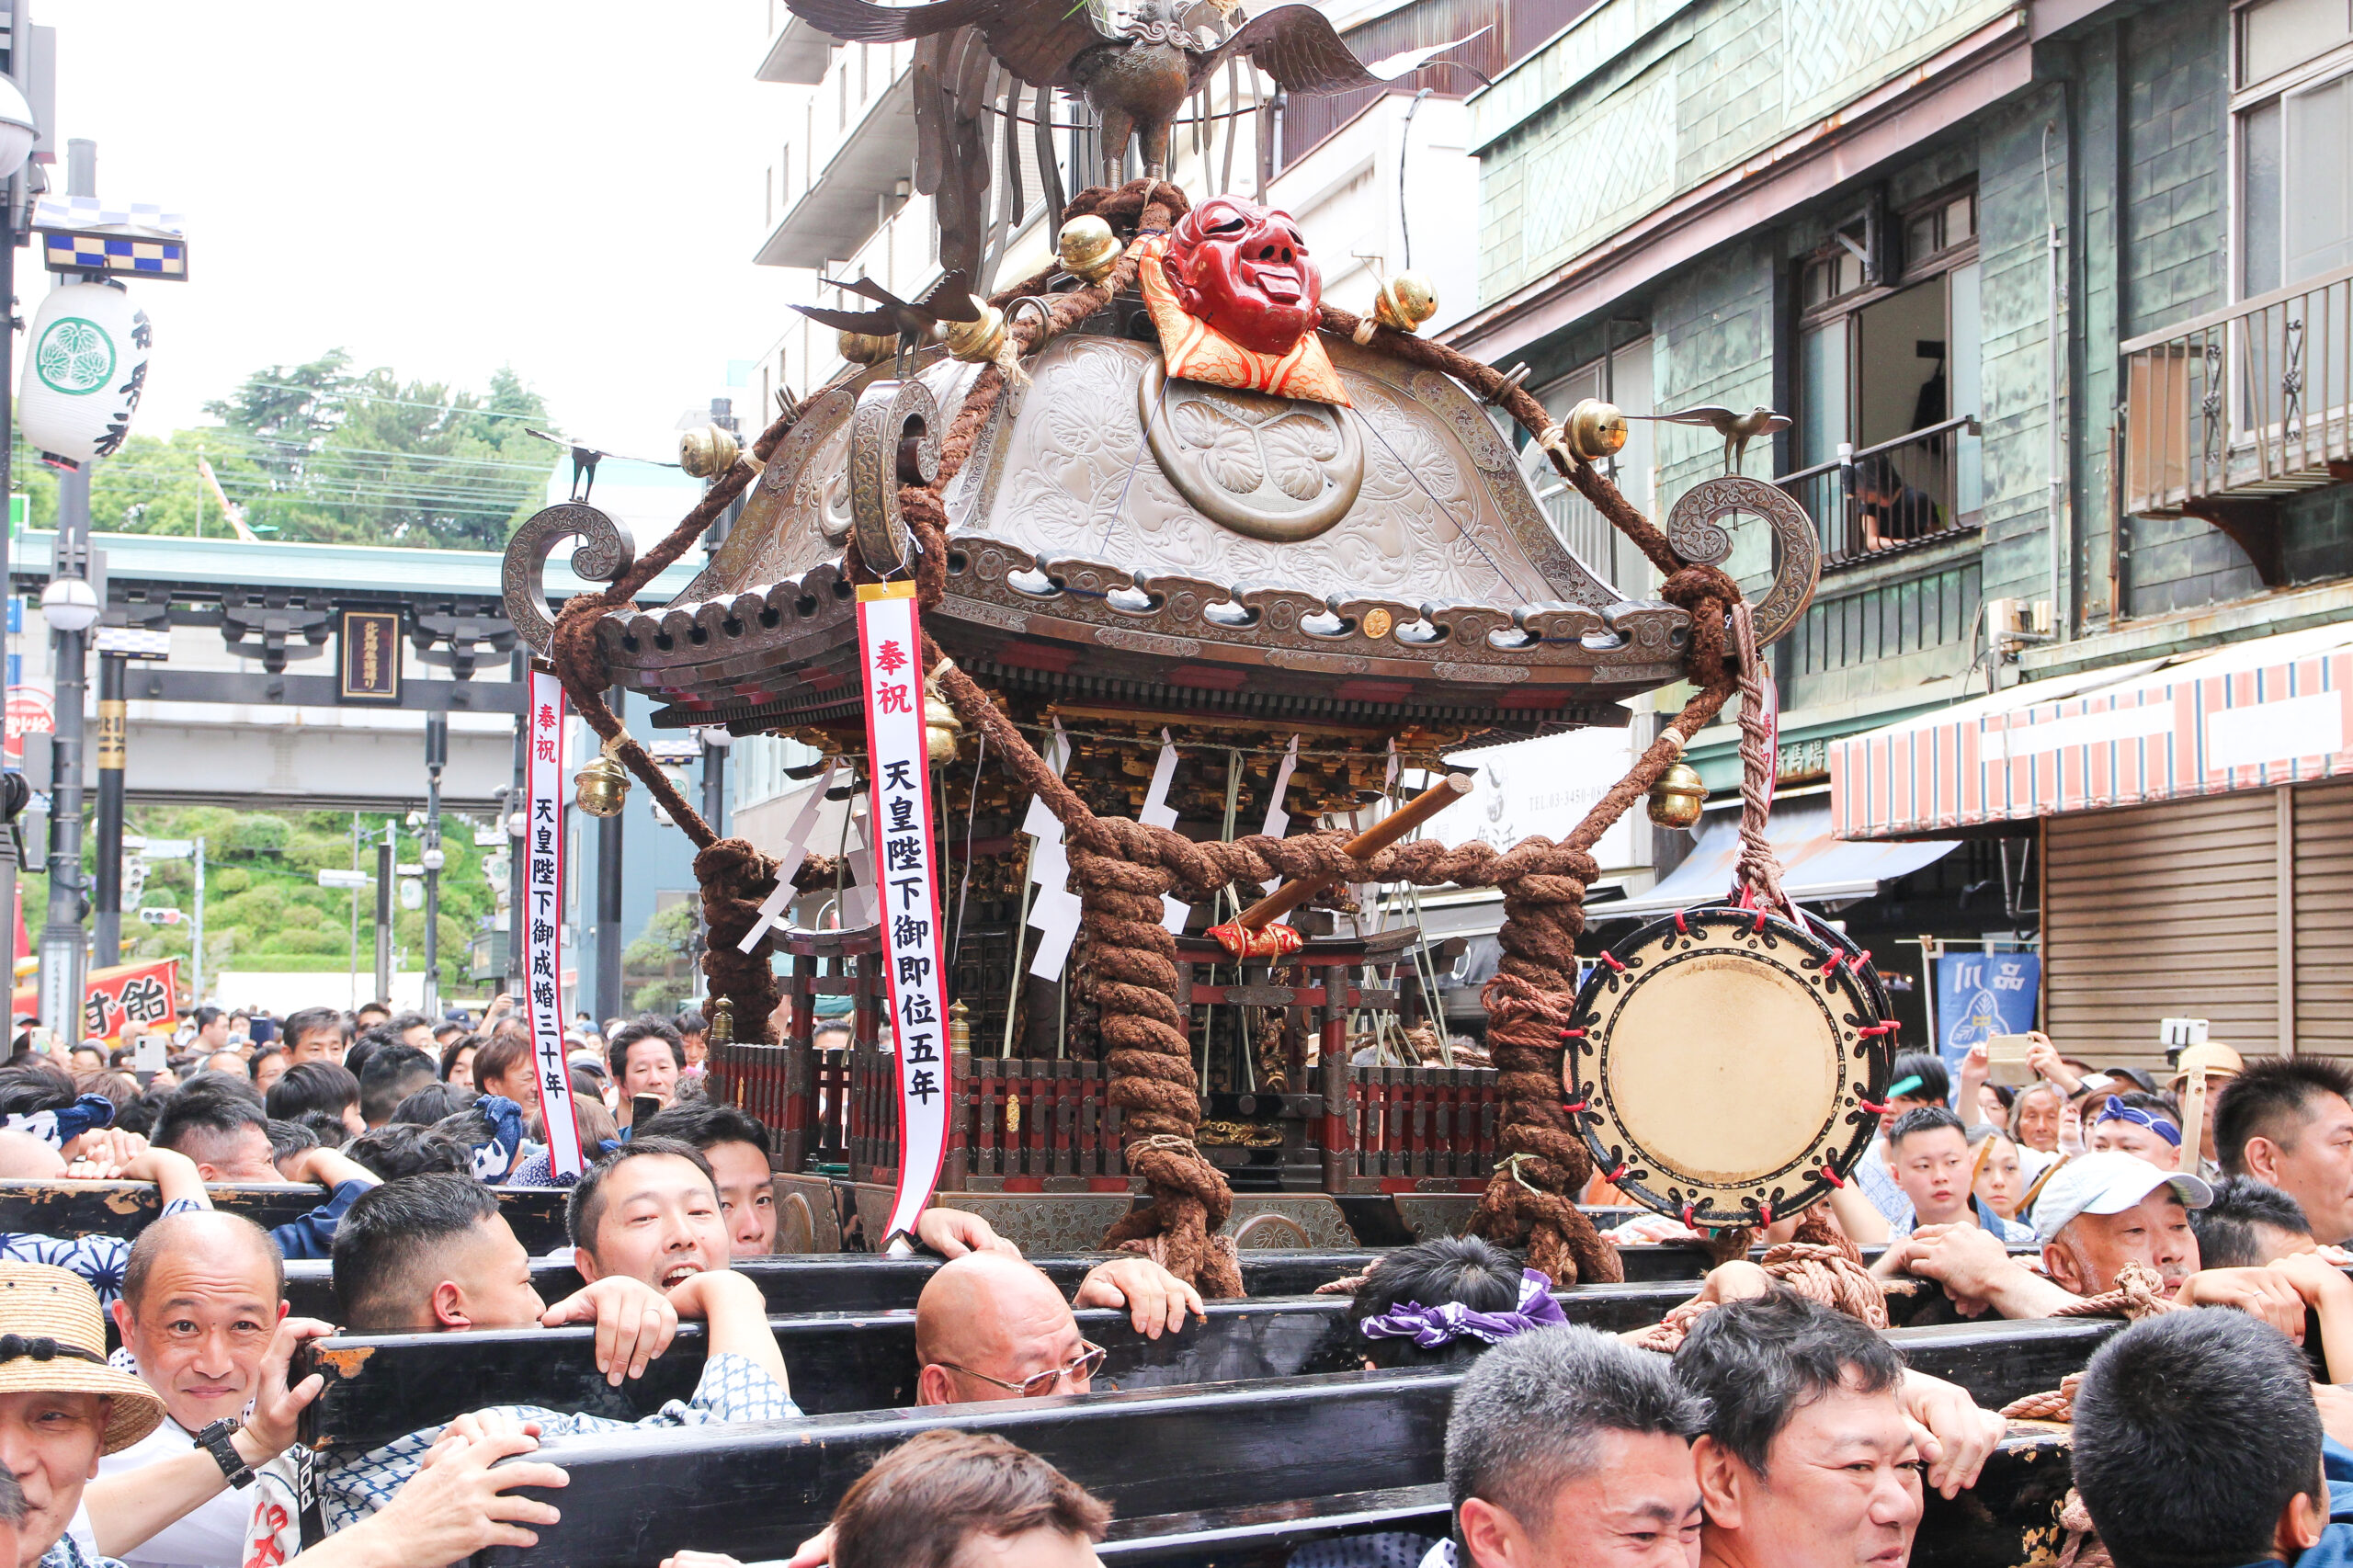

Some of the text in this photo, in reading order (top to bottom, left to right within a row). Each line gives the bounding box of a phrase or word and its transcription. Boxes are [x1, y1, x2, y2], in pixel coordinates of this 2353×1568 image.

[531, 703, 565, 1100] 奉祝 天皇陛下御成婚三十年
[874, 640, 940, 1107] 奉祝 天皇陛下御即位五年
[1529, 784, 1612, 812] TEL.03-3450-080
